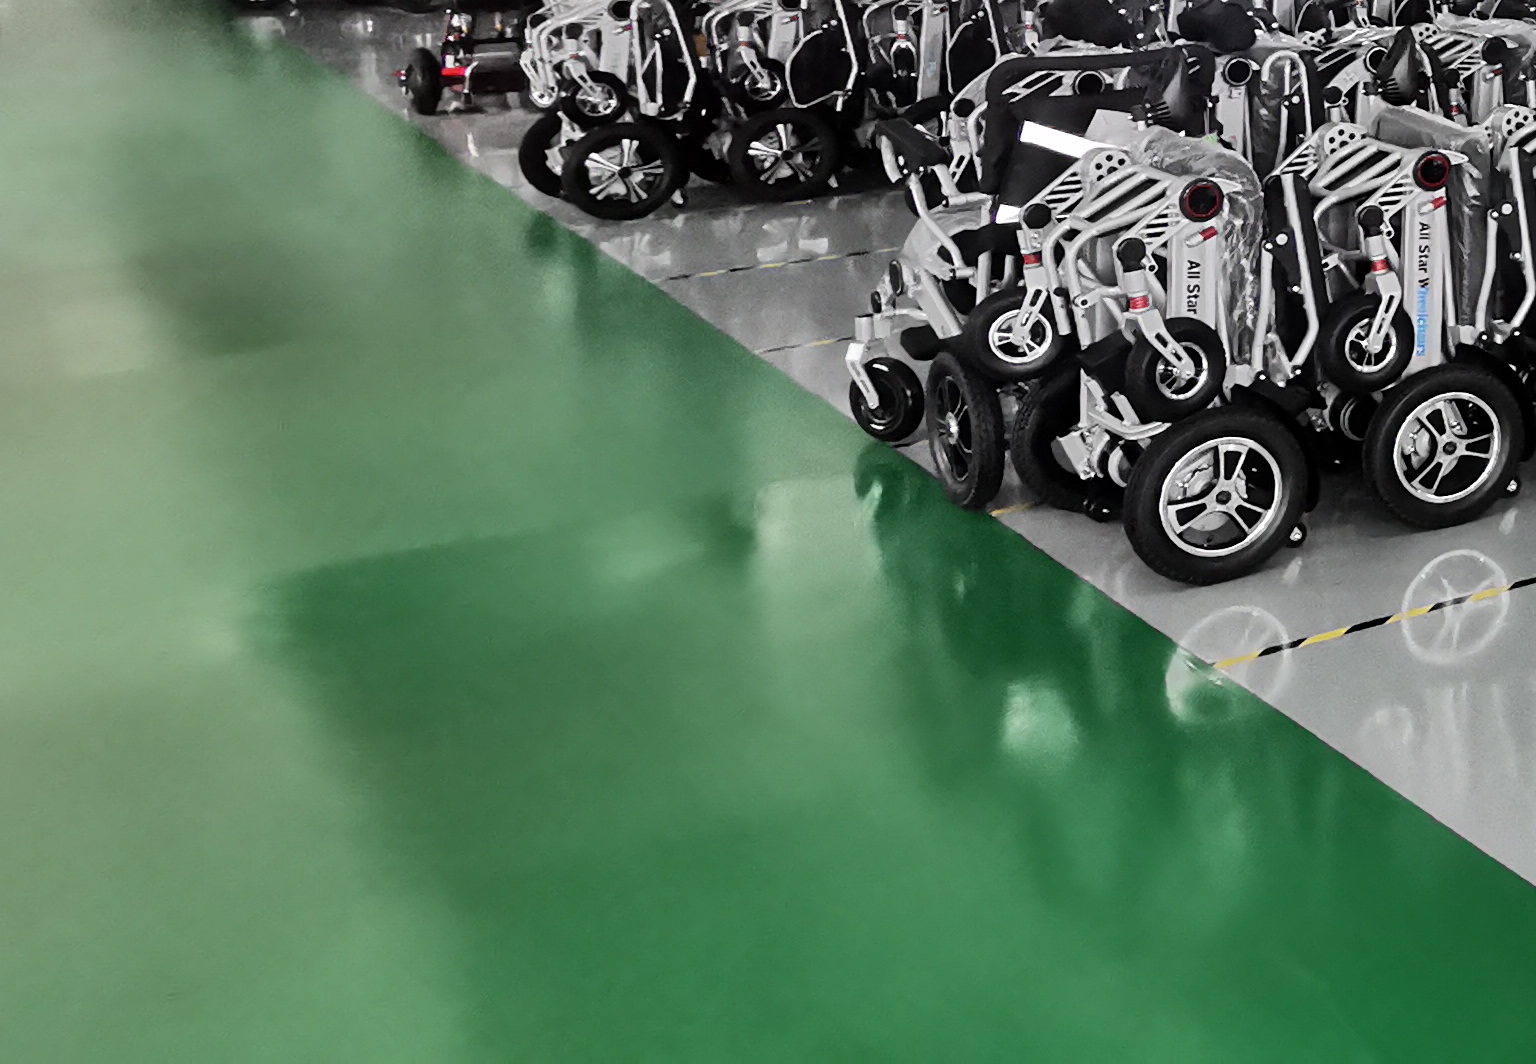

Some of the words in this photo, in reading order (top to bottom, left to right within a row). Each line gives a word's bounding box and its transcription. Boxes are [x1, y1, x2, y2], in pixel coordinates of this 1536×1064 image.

[1418, 221, 1432, 241] All
[1187, 259, 1202, 279] All
[1417, 244, 1431, 274] Star
[1186, 283, 1201, 315] Star
